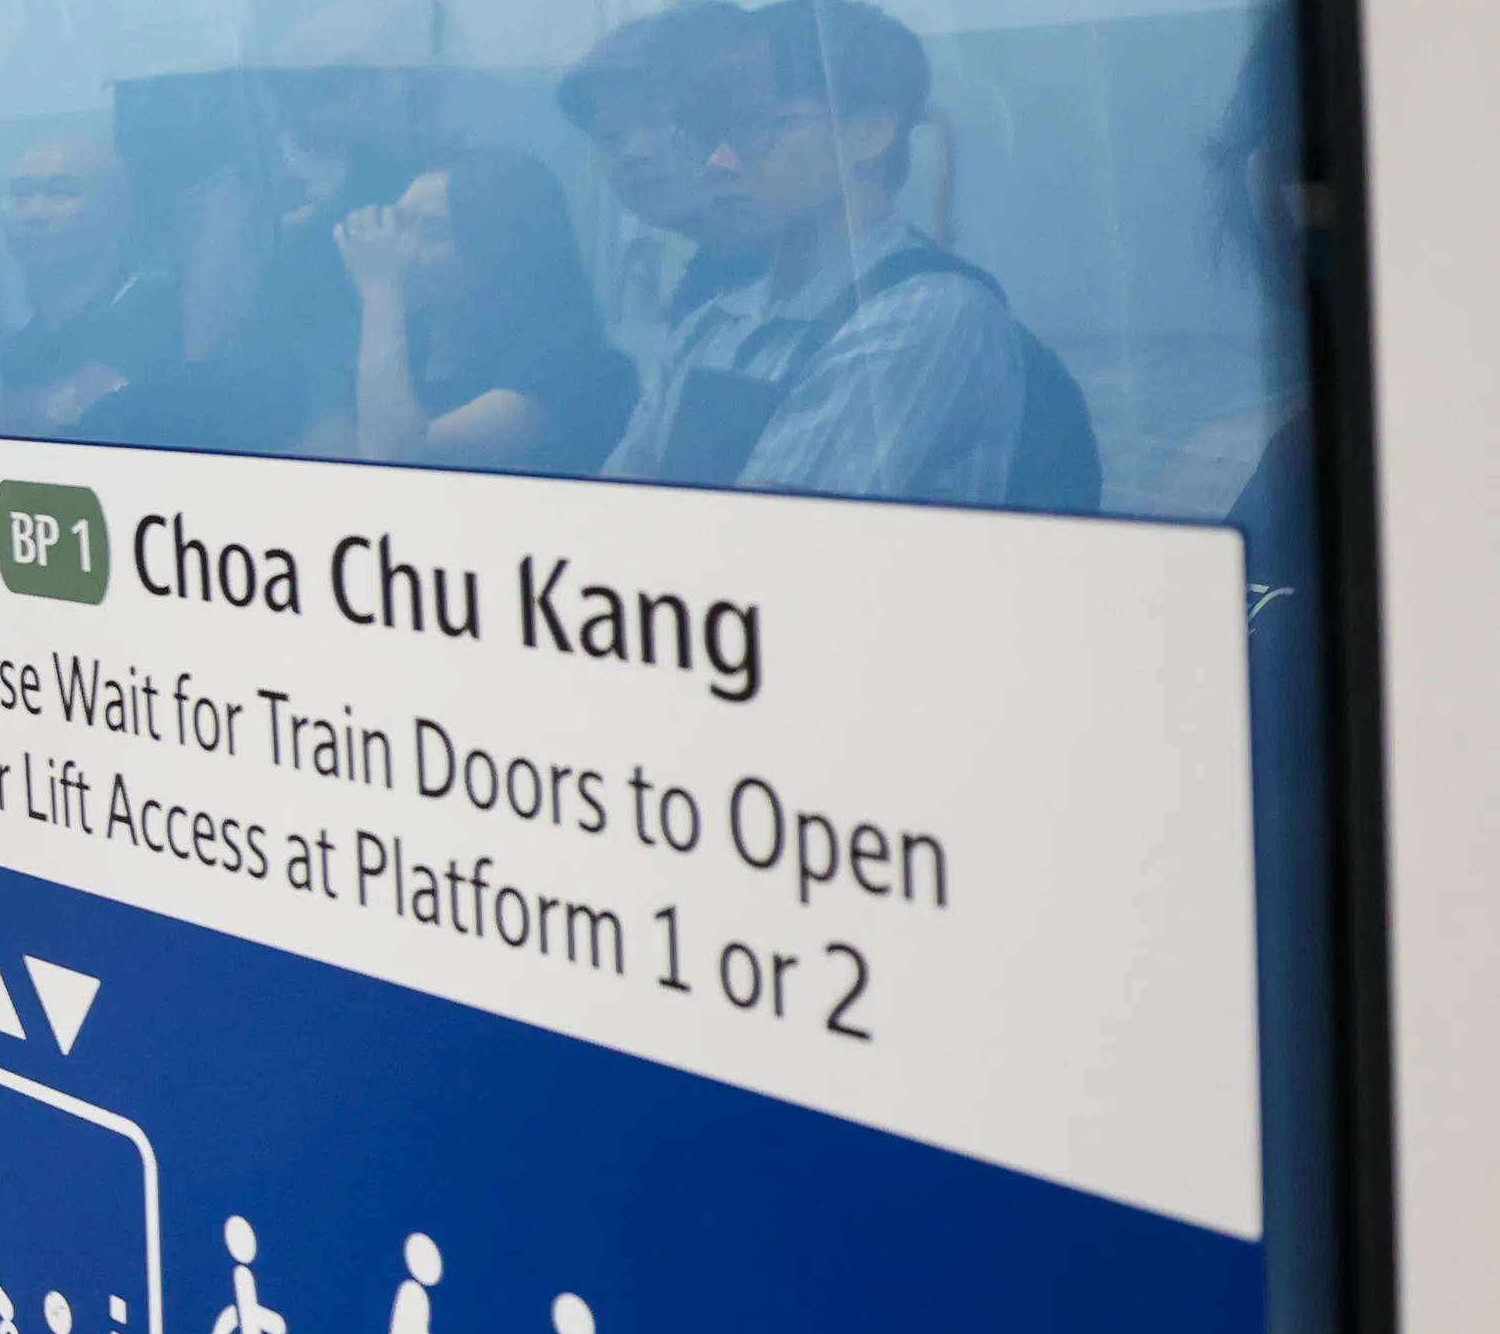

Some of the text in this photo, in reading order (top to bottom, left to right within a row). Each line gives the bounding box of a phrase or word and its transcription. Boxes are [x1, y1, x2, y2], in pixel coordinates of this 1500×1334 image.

[10, 511, 92, 573] BP 1
[134, 513, 761, 704] Choa Chu Kang
[52, 652, 161, 741] Wait
[173, 673, 243, 755] for
[257, 689, 392, 789] Train
[415, 718, 606, 834] Doors
[628, 767, 700, 853] to
[730, 777, 946, 907] Open
[24, 752, 93, 835] Lift
[107, 773, 268, 879] Access
[287, 830, 337, 899] at
[357, 830, 623, 974] Platform
[655, 906, 690, 992] 1
[720, 942, 797, 1017] or
[826, 943, 871, 1040] 2
